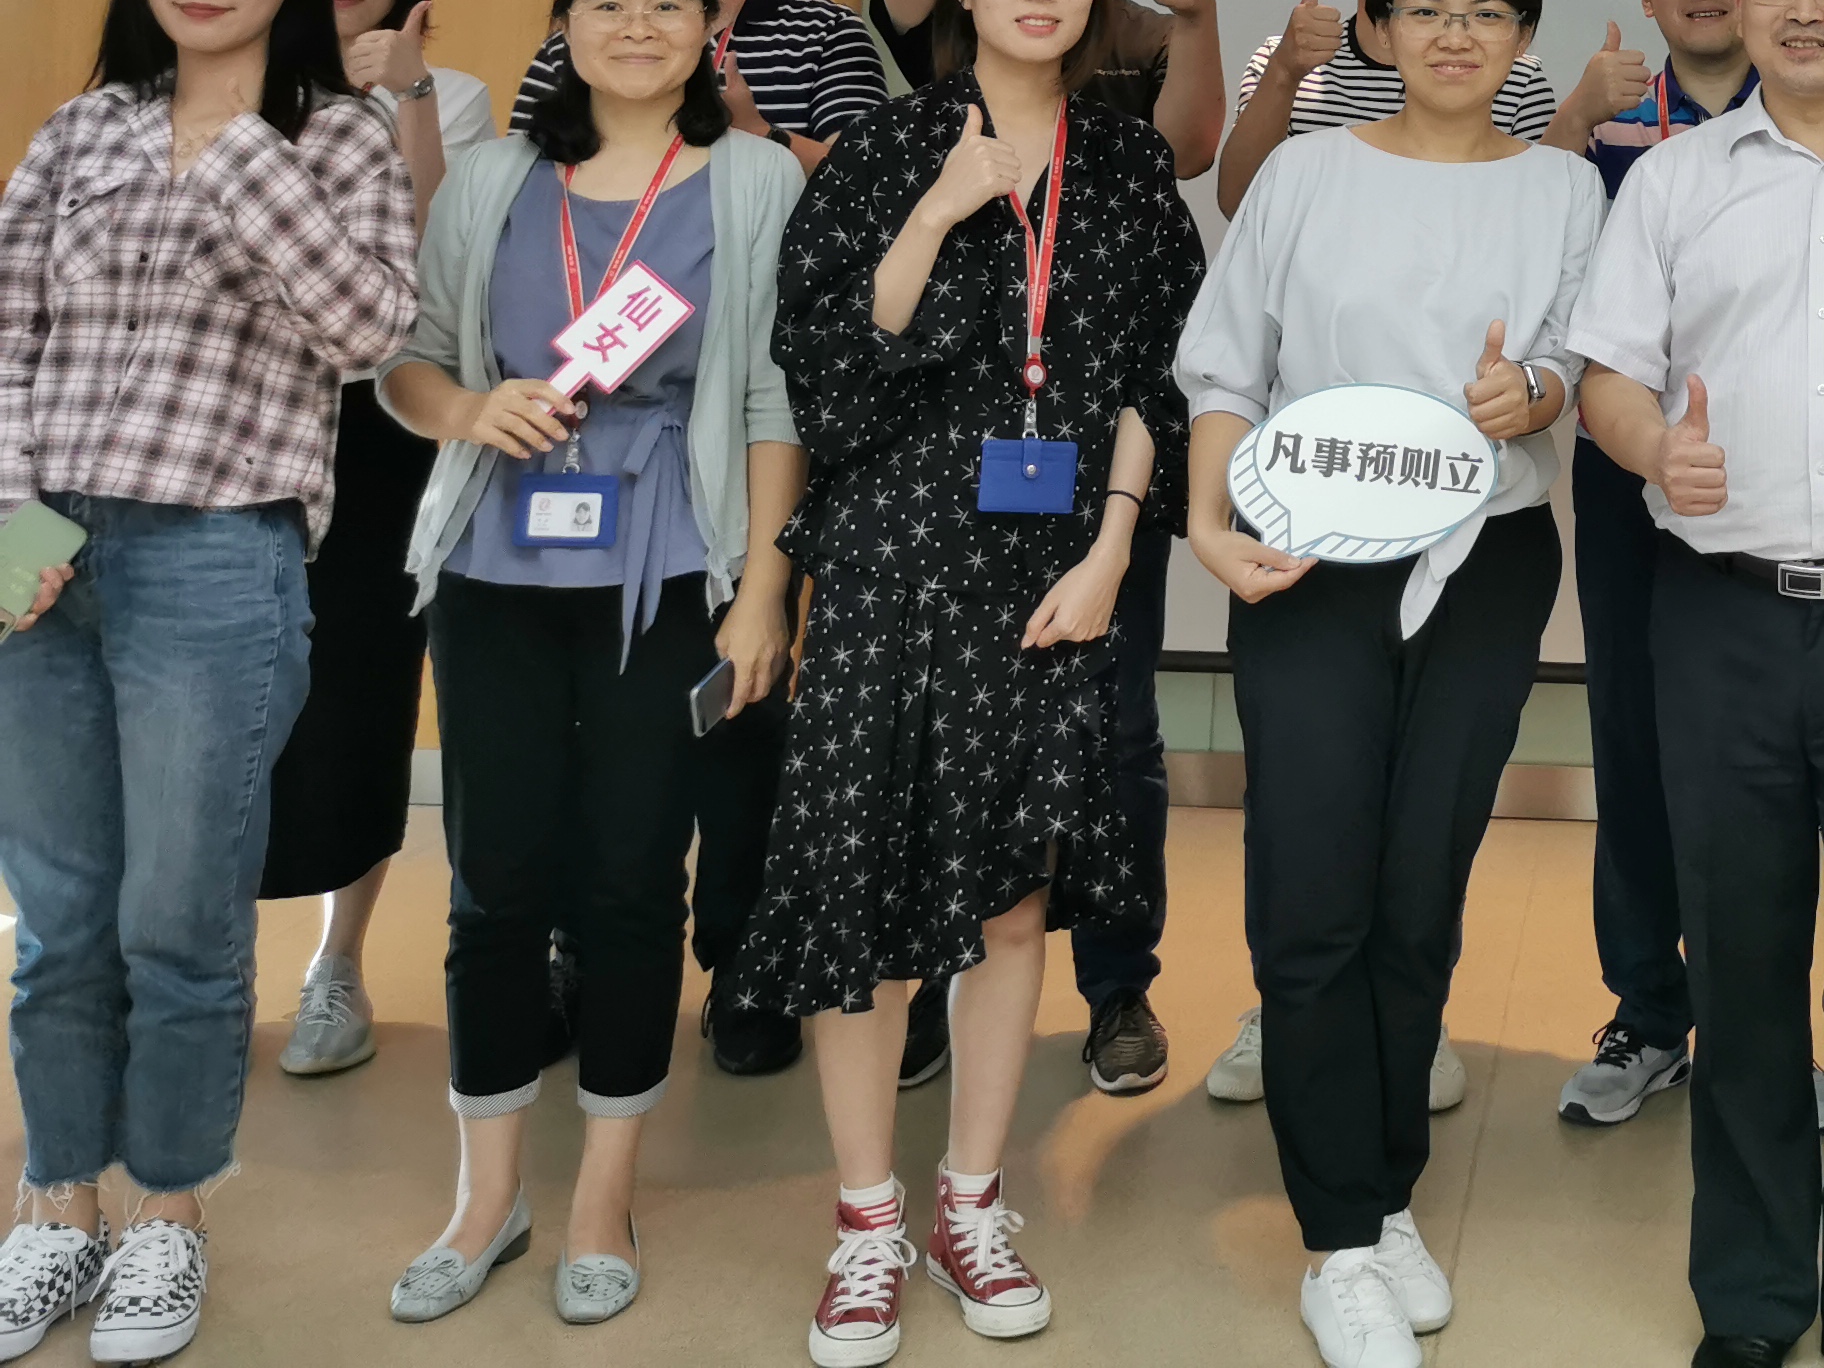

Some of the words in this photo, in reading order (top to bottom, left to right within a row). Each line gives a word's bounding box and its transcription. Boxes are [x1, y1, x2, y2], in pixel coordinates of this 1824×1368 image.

[582, 285, 663, 363] 仙女
[1264, 429, 1485, 496] 凡事预则立
